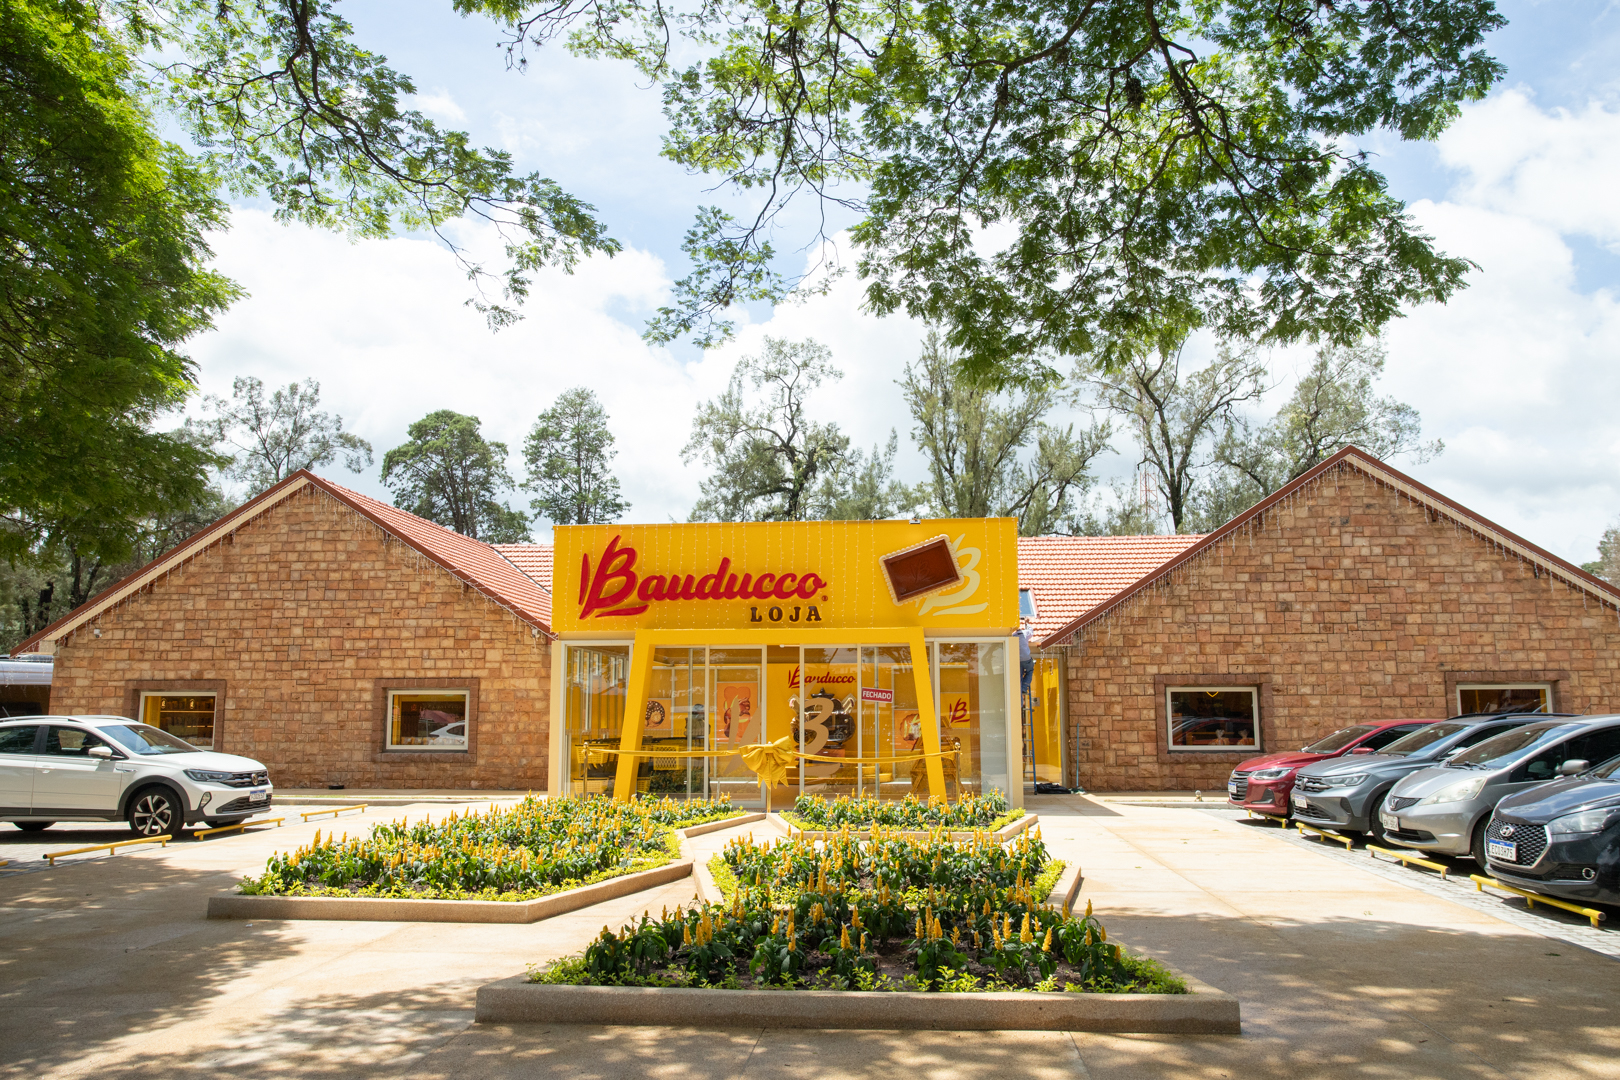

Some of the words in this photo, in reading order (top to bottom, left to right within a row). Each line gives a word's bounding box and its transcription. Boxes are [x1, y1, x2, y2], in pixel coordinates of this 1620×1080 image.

[579, 534, 827, 619] Bauducco
[750, 605, 822, 622] LOJA
[862, 690, 892, 700] FECHADO
